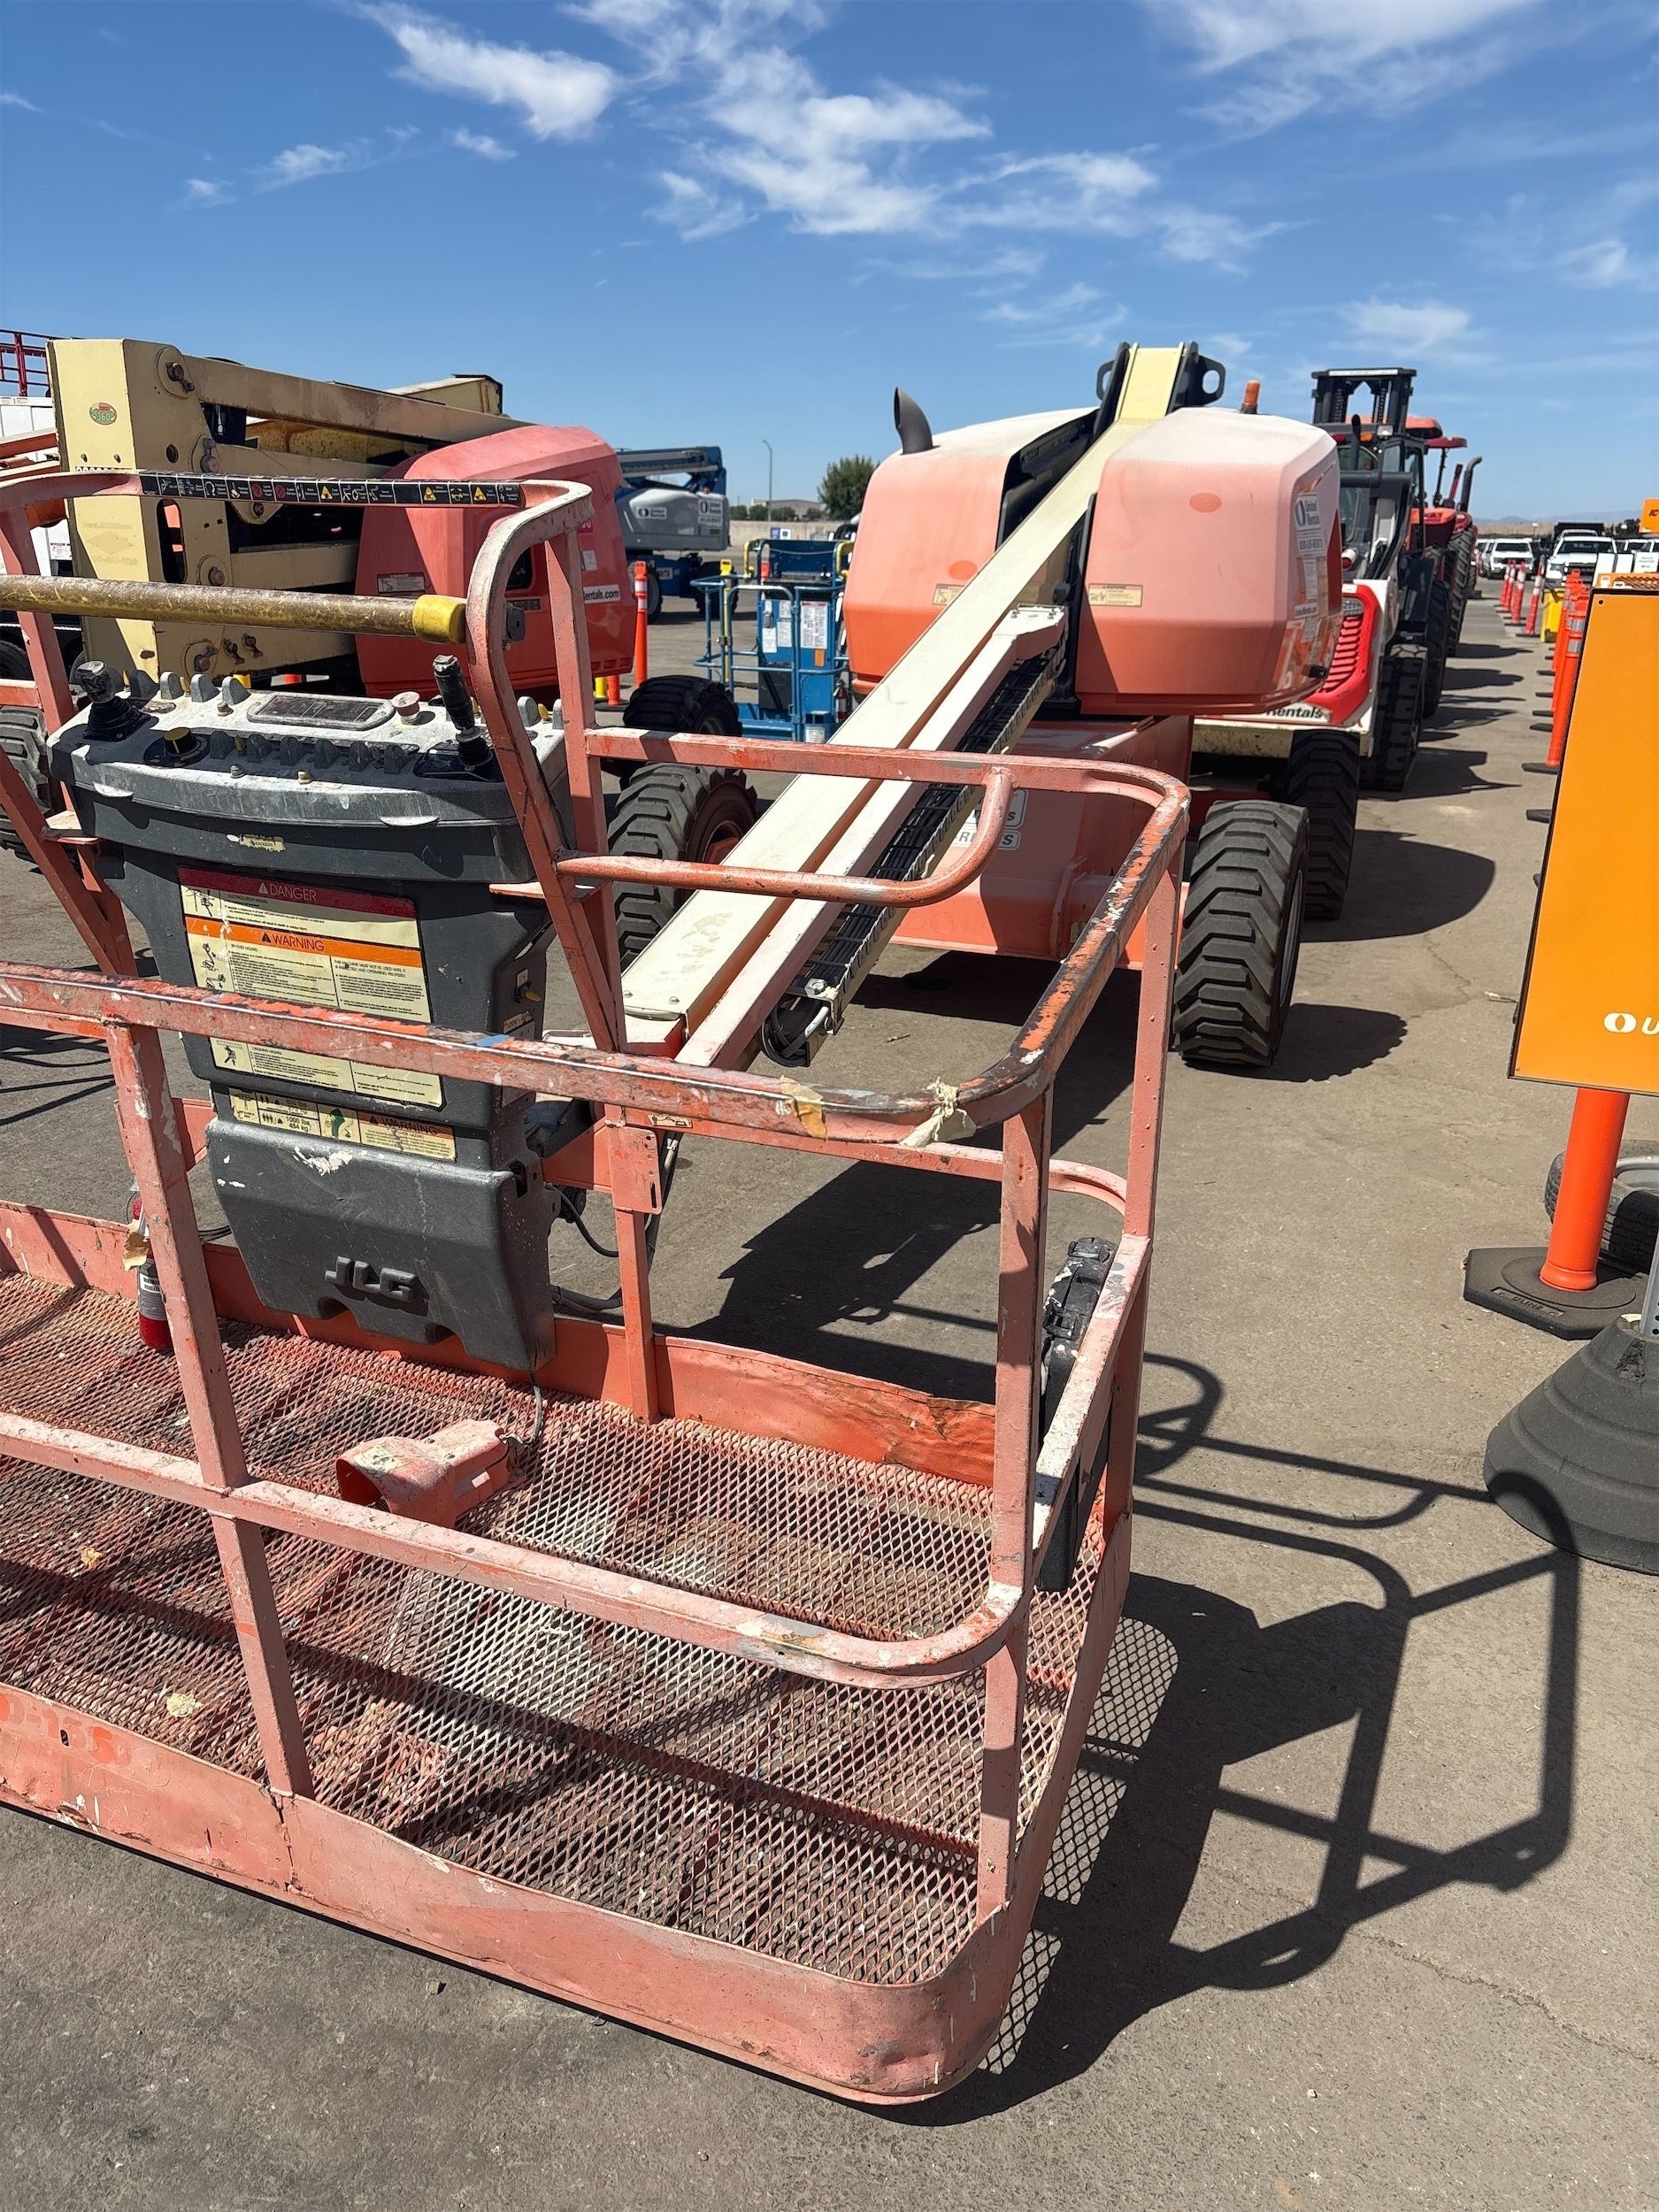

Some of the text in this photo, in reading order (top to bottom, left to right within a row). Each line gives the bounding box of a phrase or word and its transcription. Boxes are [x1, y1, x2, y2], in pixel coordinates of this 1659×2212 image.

[584, 590, 618, 601] entals.com
[269, 883, 317, 902] DANGER
[272, 933, 325, 952] WARNING
[380, 1117, 439, 1136] WARNING
[324, 1256, 416, 1303] JLG
